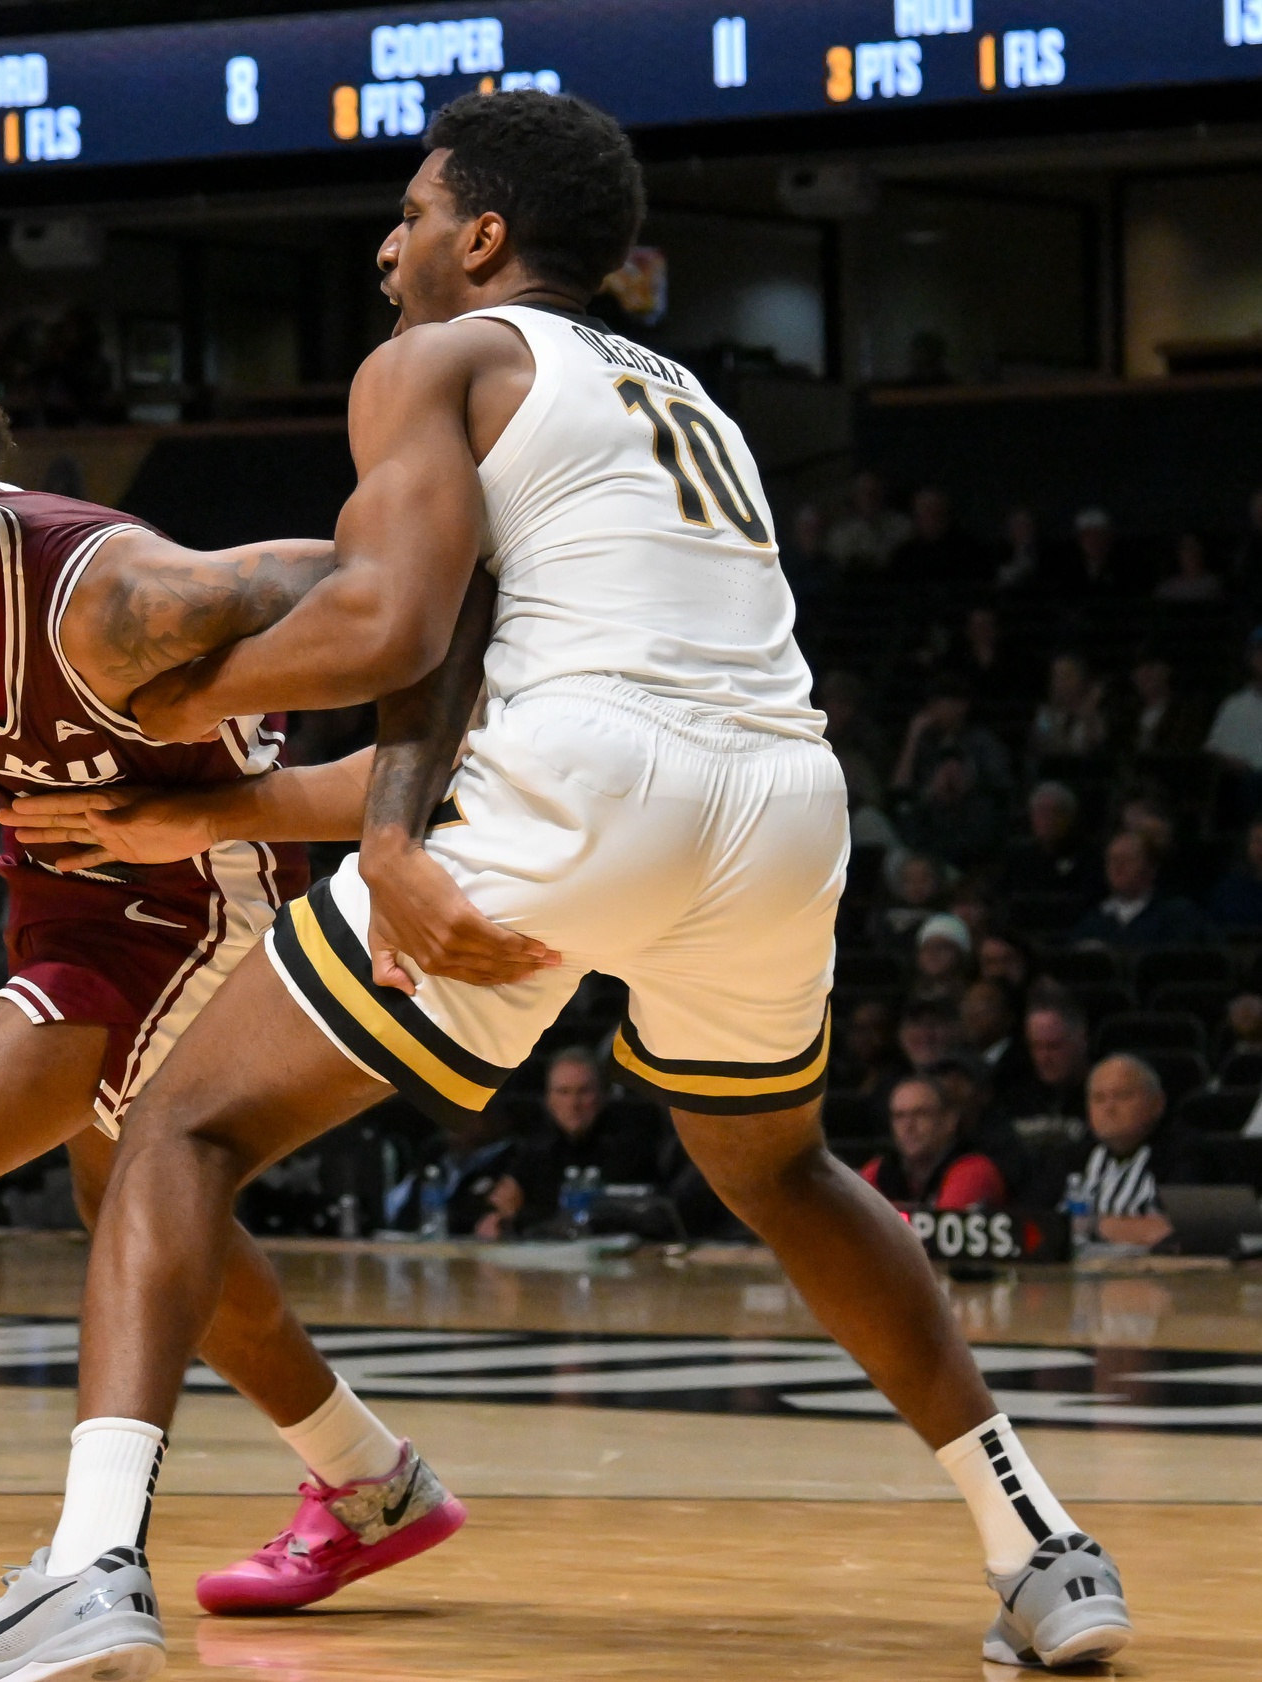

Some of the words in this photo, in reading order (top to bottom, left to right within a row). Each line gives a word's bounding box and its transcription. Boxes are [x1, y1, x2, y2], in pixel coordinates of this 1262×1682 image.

[371, 18, 504, 80] COOPER
[855, 40, 923, 100] PTS
[1003, 27, 1065, 88] FLS
[225, 56, 259, 125] 8
[360, 80, 425, 138] PTS
[25, 106, 81, 161] FLS
[613, 373, 773, 548] 10
